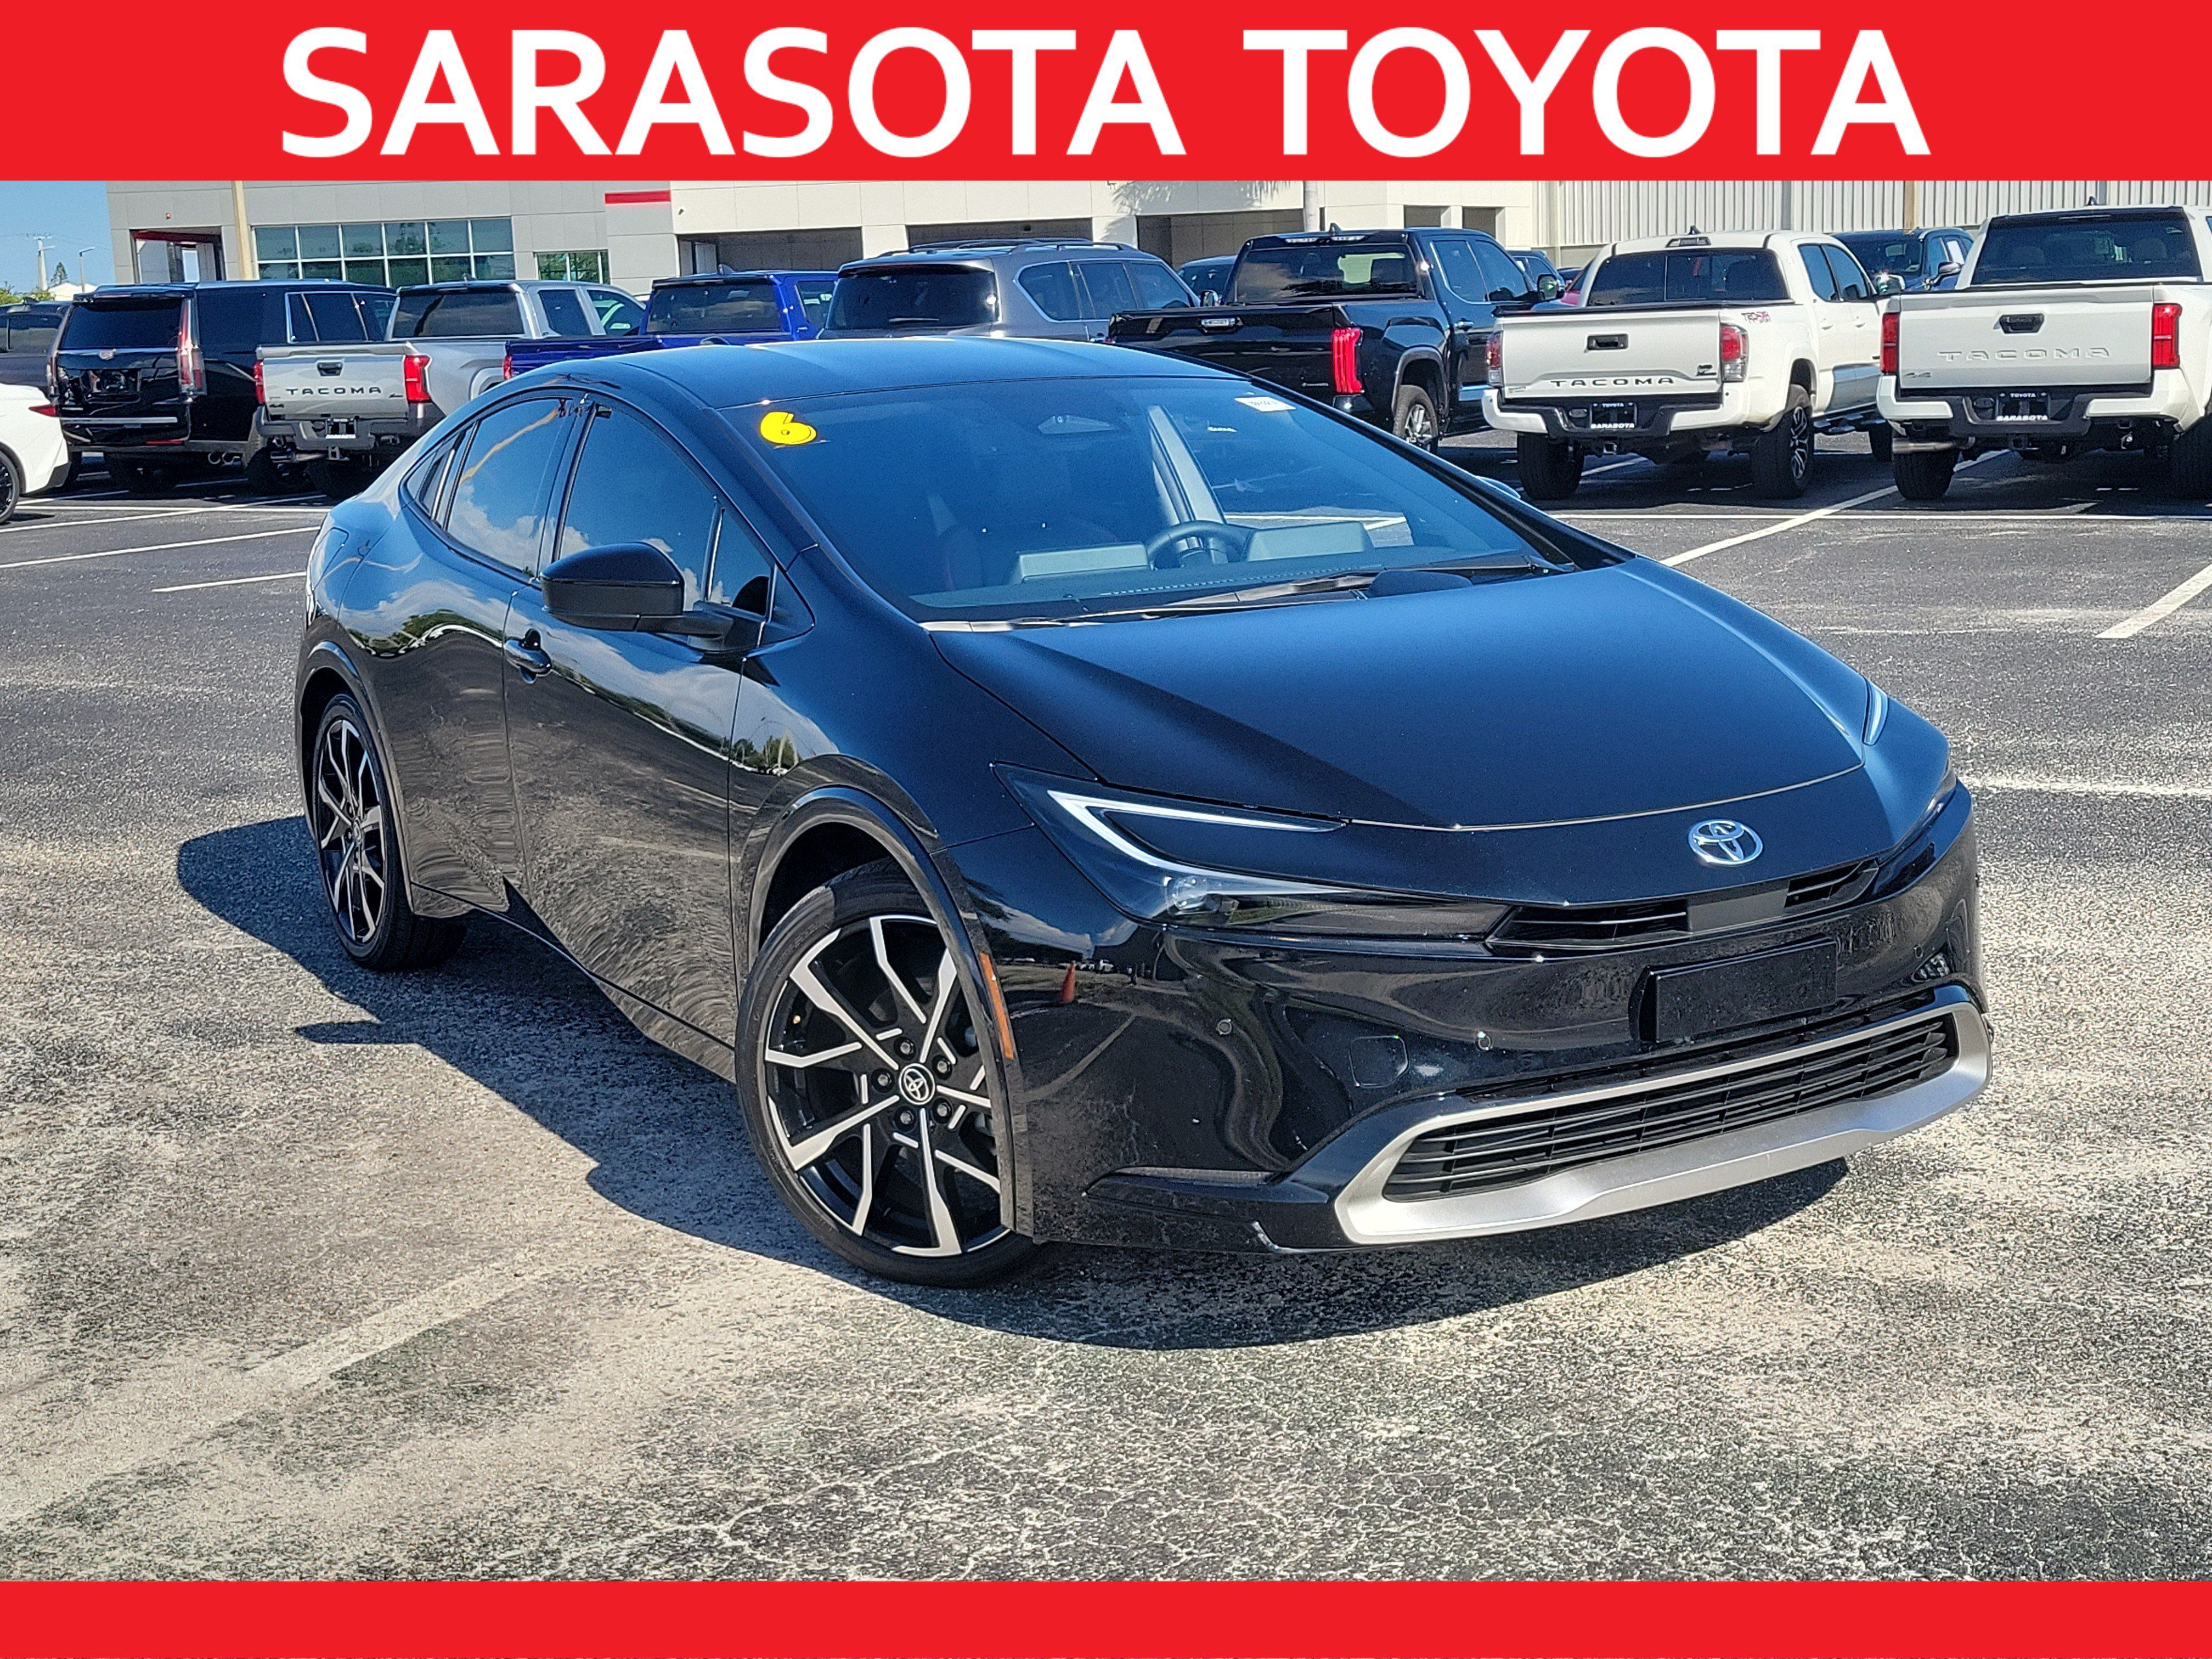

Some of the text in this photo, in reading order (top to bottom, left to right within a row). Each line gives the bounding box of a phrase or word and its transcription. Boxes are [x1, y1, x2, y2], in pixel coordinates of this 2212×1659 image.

[1937, 348, 2110, 362] TACOMA
[1550, 377, 1674, 387] TACOMA
[286, 387, 381, 395] TACOMA
[760, 411, 816, 445] 6
